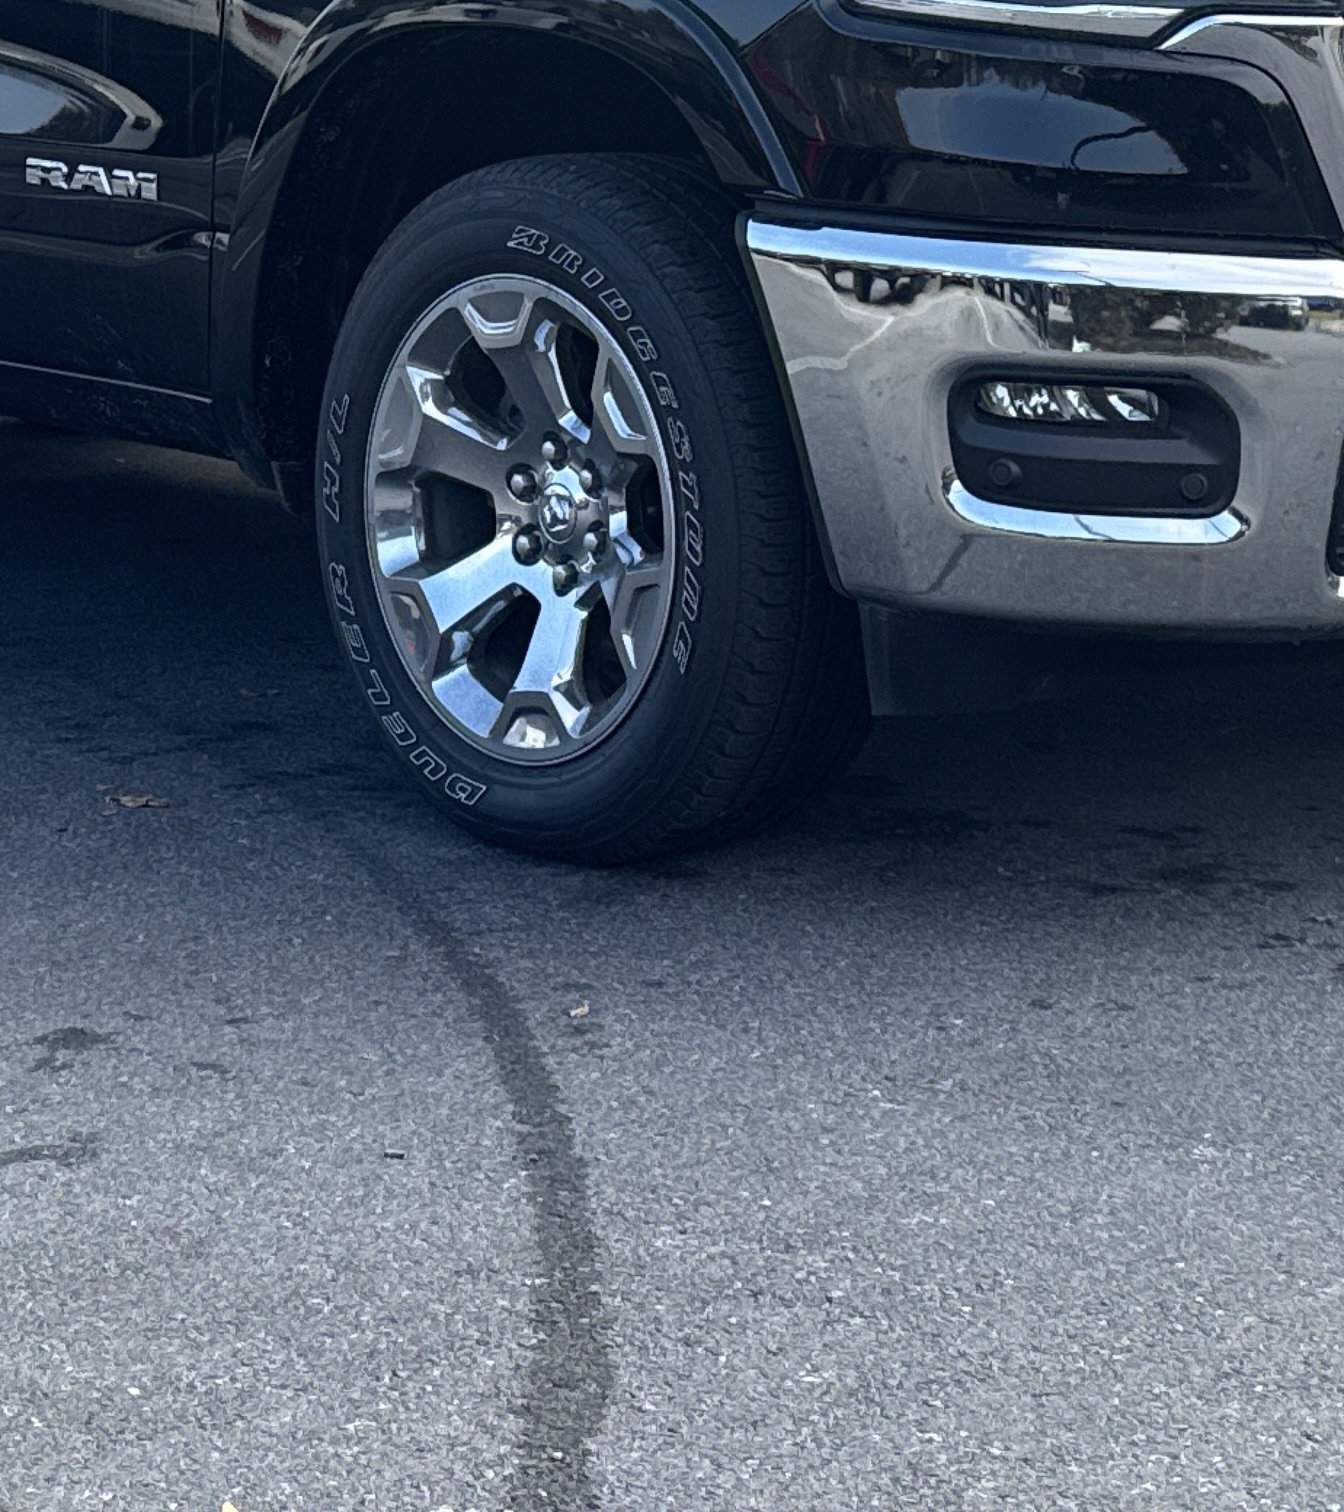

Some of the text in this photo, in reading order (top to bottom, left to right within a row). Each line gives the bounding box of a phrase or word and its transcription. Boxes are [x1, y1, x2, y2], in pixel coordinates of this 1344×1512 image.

[25, 157, 158, 201] RAM
[507, 225, 705, 674] BRIDGESTONE
[329, 561, 486, 806] DUELER
